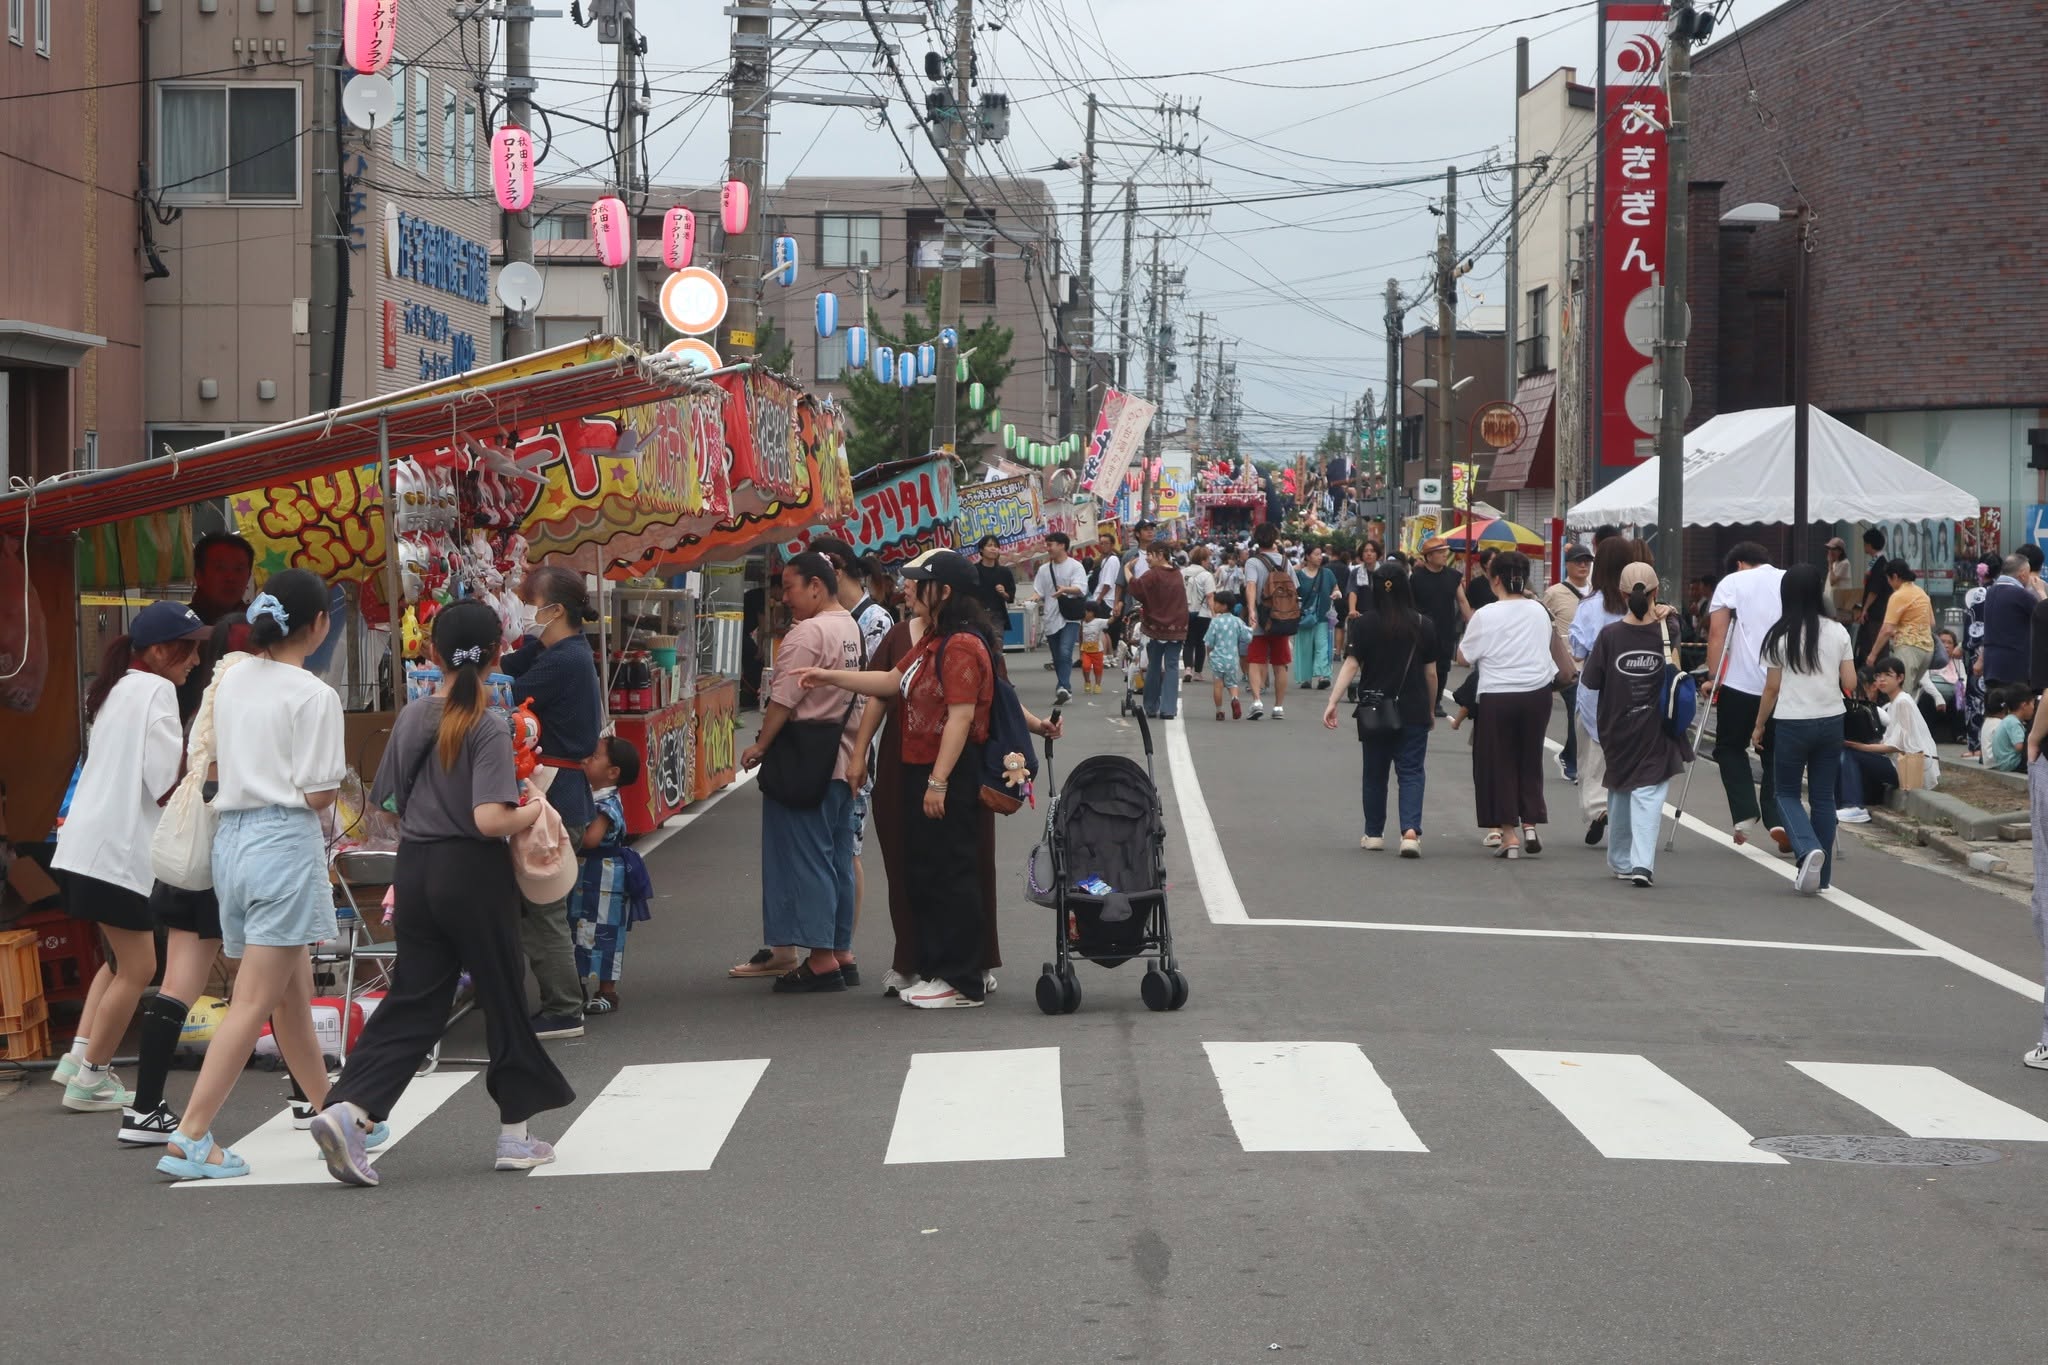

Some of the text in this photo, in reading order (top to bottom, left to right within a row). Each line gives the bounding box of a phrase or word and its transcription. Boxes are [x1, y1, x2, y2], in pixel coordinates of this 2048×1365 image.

[504, 138, 520, 204] ロータリークラブ
[518, 137, 528, 171] 秋田港
[1621, 101, 1656, 272] あきぎん
[669, 214, 683, 264] ロータリークラブ
[260, 469, 357, 535] ふり
[960, 497, 1032, 546] 生レモンサワー
[1626, 655, 1658, 671] mildly
